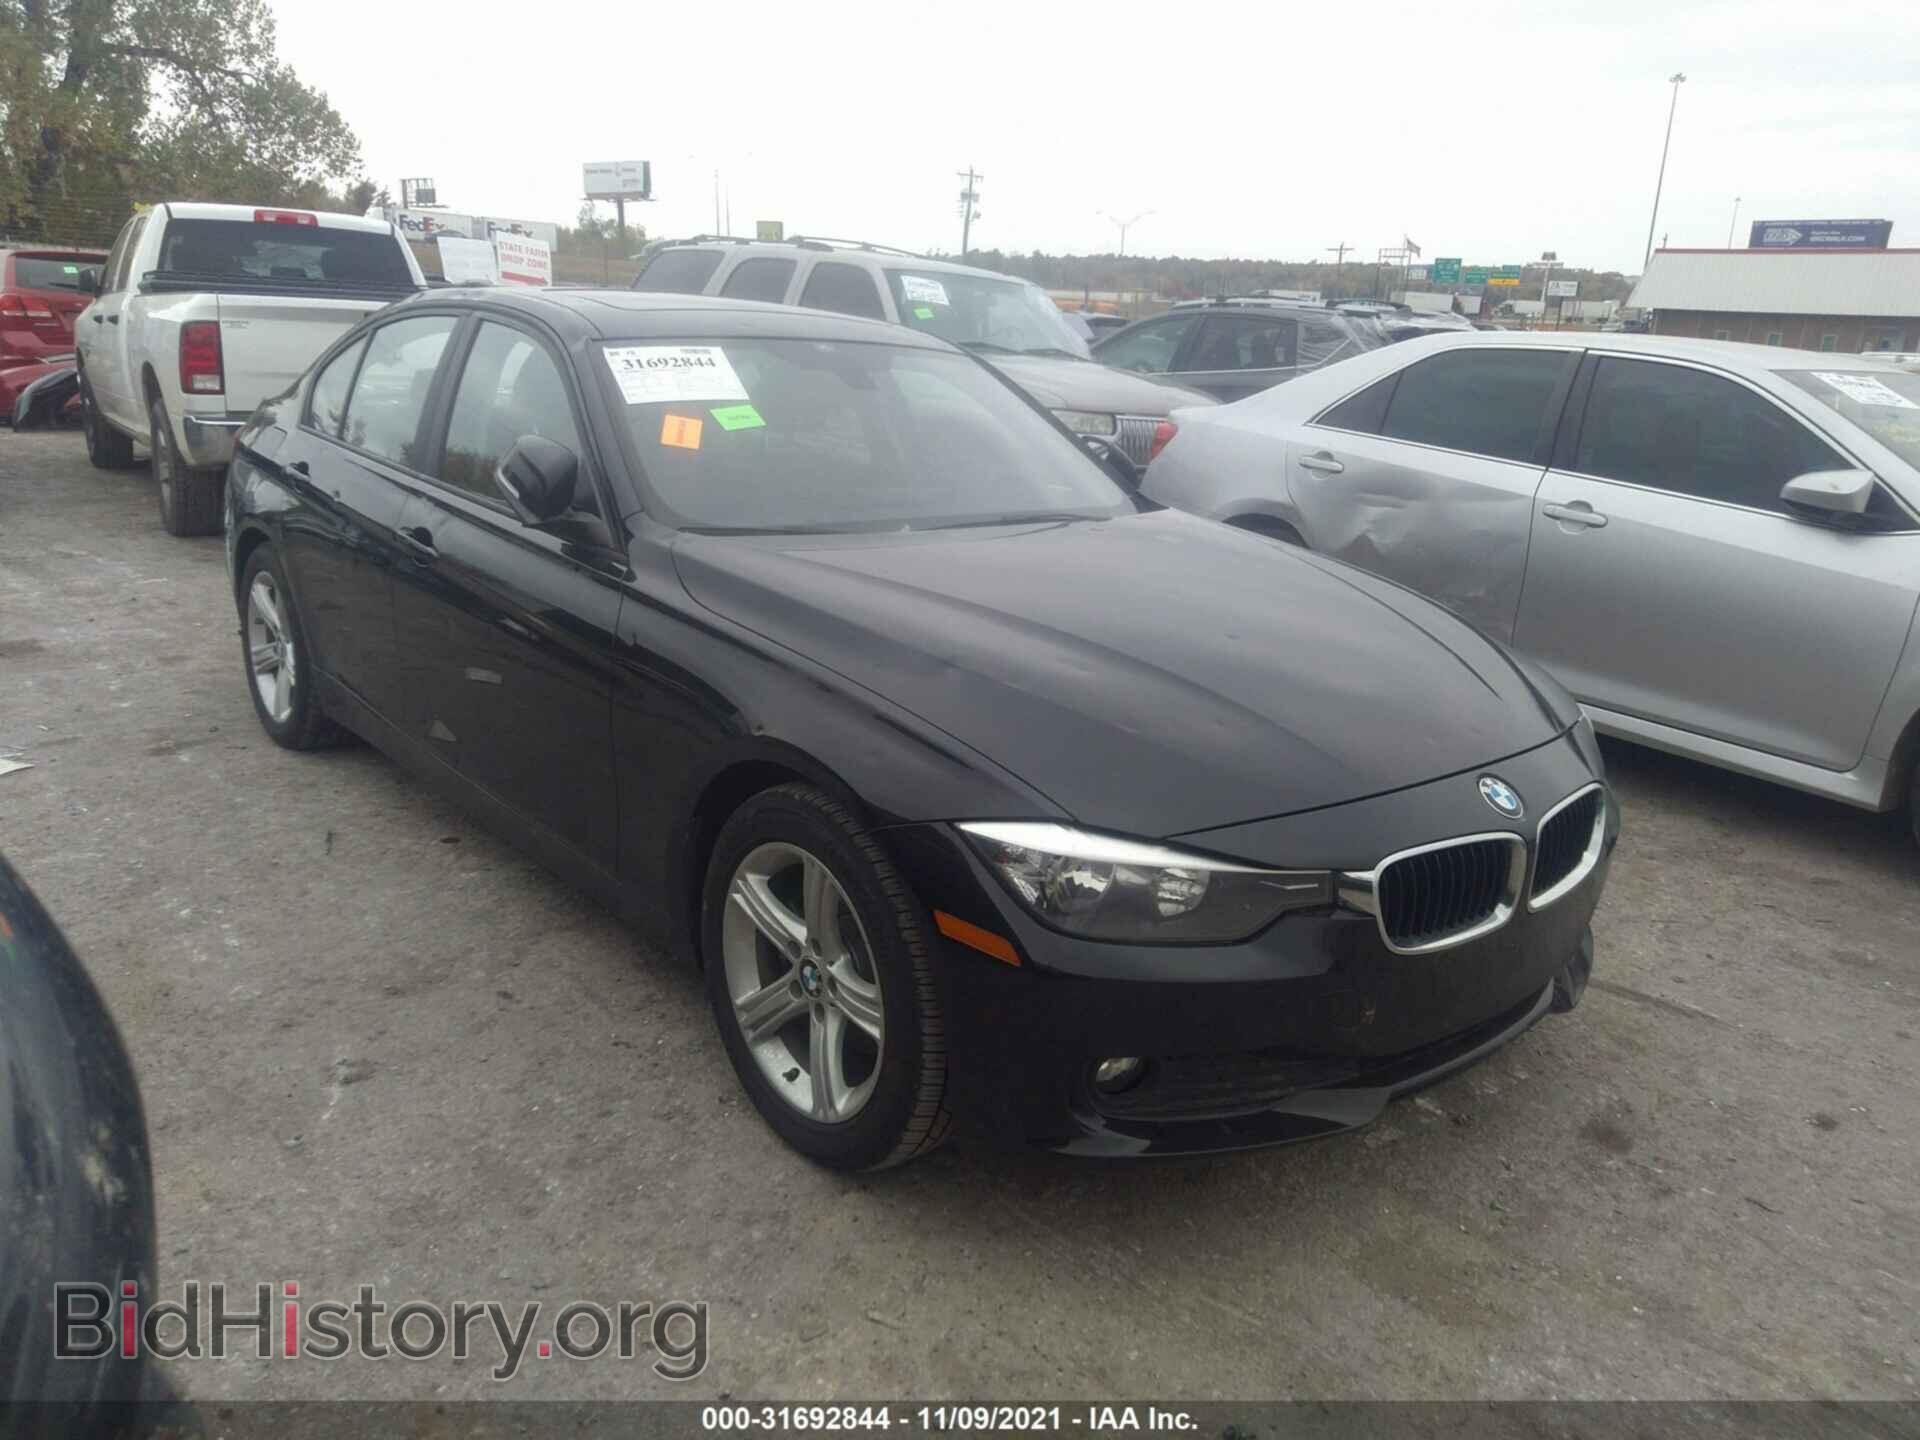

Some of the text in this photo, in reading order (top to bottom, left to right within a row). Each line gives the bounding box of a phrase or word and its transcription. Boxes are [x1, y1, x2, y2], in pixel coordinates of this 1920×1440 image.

[499, 241, 548, 257] STATE FARM
[622, 356, 716, 370] 31692844
